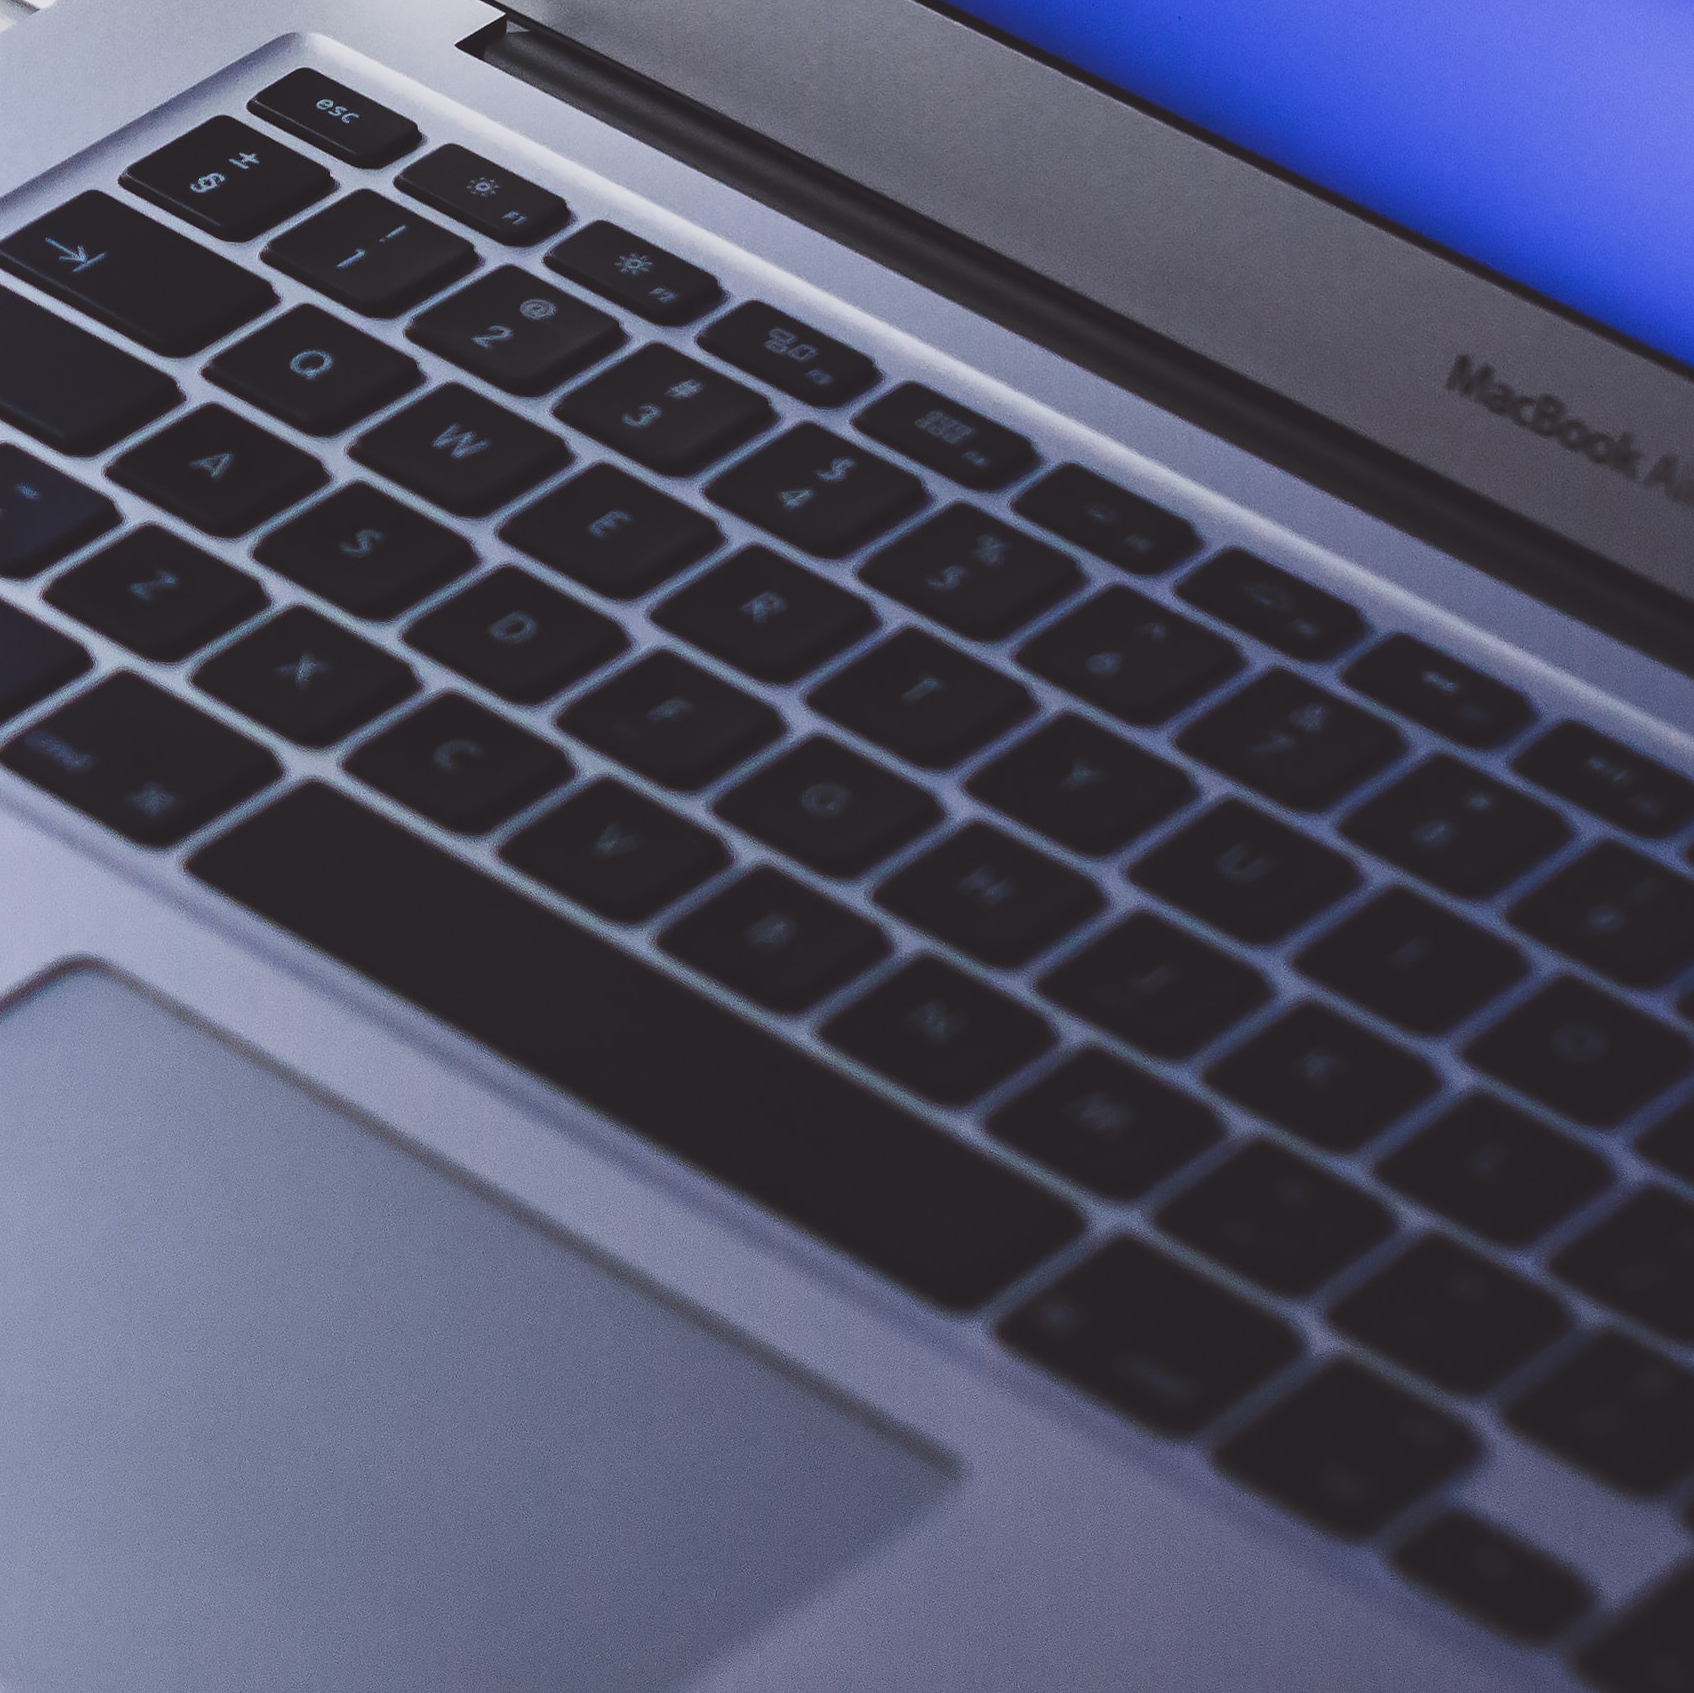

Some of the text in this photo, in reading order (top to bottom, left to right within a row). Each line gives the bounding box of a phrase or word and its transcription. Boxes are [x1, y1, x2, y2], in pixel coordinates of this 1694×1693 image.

[315, 97, 361, 126] esc
[337, 248, 366, 268] 1
[472, 325, 512, 349] 2
[289, 349, 333, 380] Q
[623, 404, 661, 428] 3
[1445, 354, 1644, 483] MacBook
[432, 424, 488, 459] W
[192, 452, 232, 478] A
[818, 458, 854, 482] $
[780, 489, 813, 509] 4
[588, 510, 631, 537] E
[342, 529, 382, 555] S
[129, 570, 178, 600] Z
[928, 565, 965, 590] 5
[744, 592, 783, 619] R
[488, 611, 537, 644] D
[273, 651, 333, 688] X
[904, 676, 941, 700] T
[433, 740, 481, 771] C
